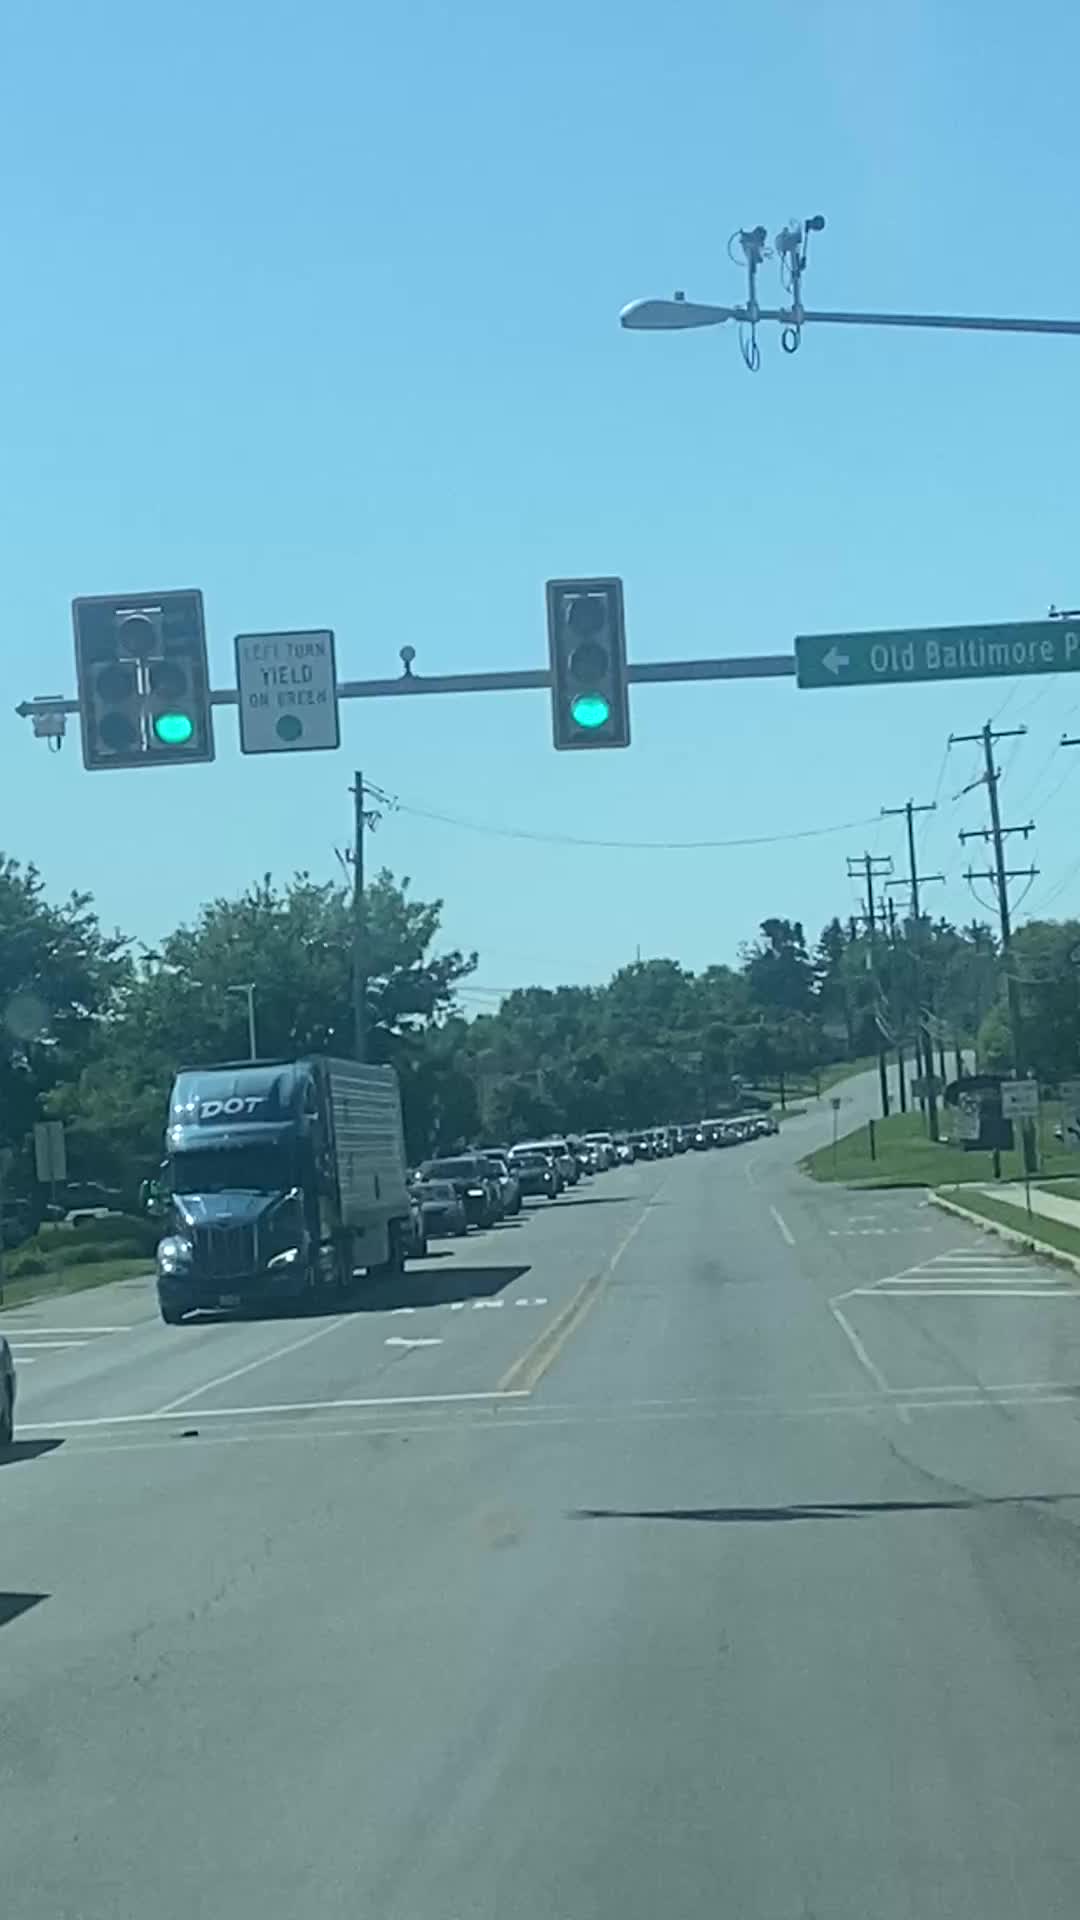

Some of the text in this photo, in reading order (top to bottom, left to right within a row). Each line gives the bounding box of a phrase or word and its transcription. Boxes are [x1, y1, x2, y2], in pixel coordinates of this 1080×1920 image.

[244, 642, 326, 660] LEFT TURN
[870, 631, 1080, 672] Old Baltimore P
[260, 664, 313, 686] YIELD
[249, 689, 327, 708] ON GREEN
[200, 1097, 265, 1119] DOT
